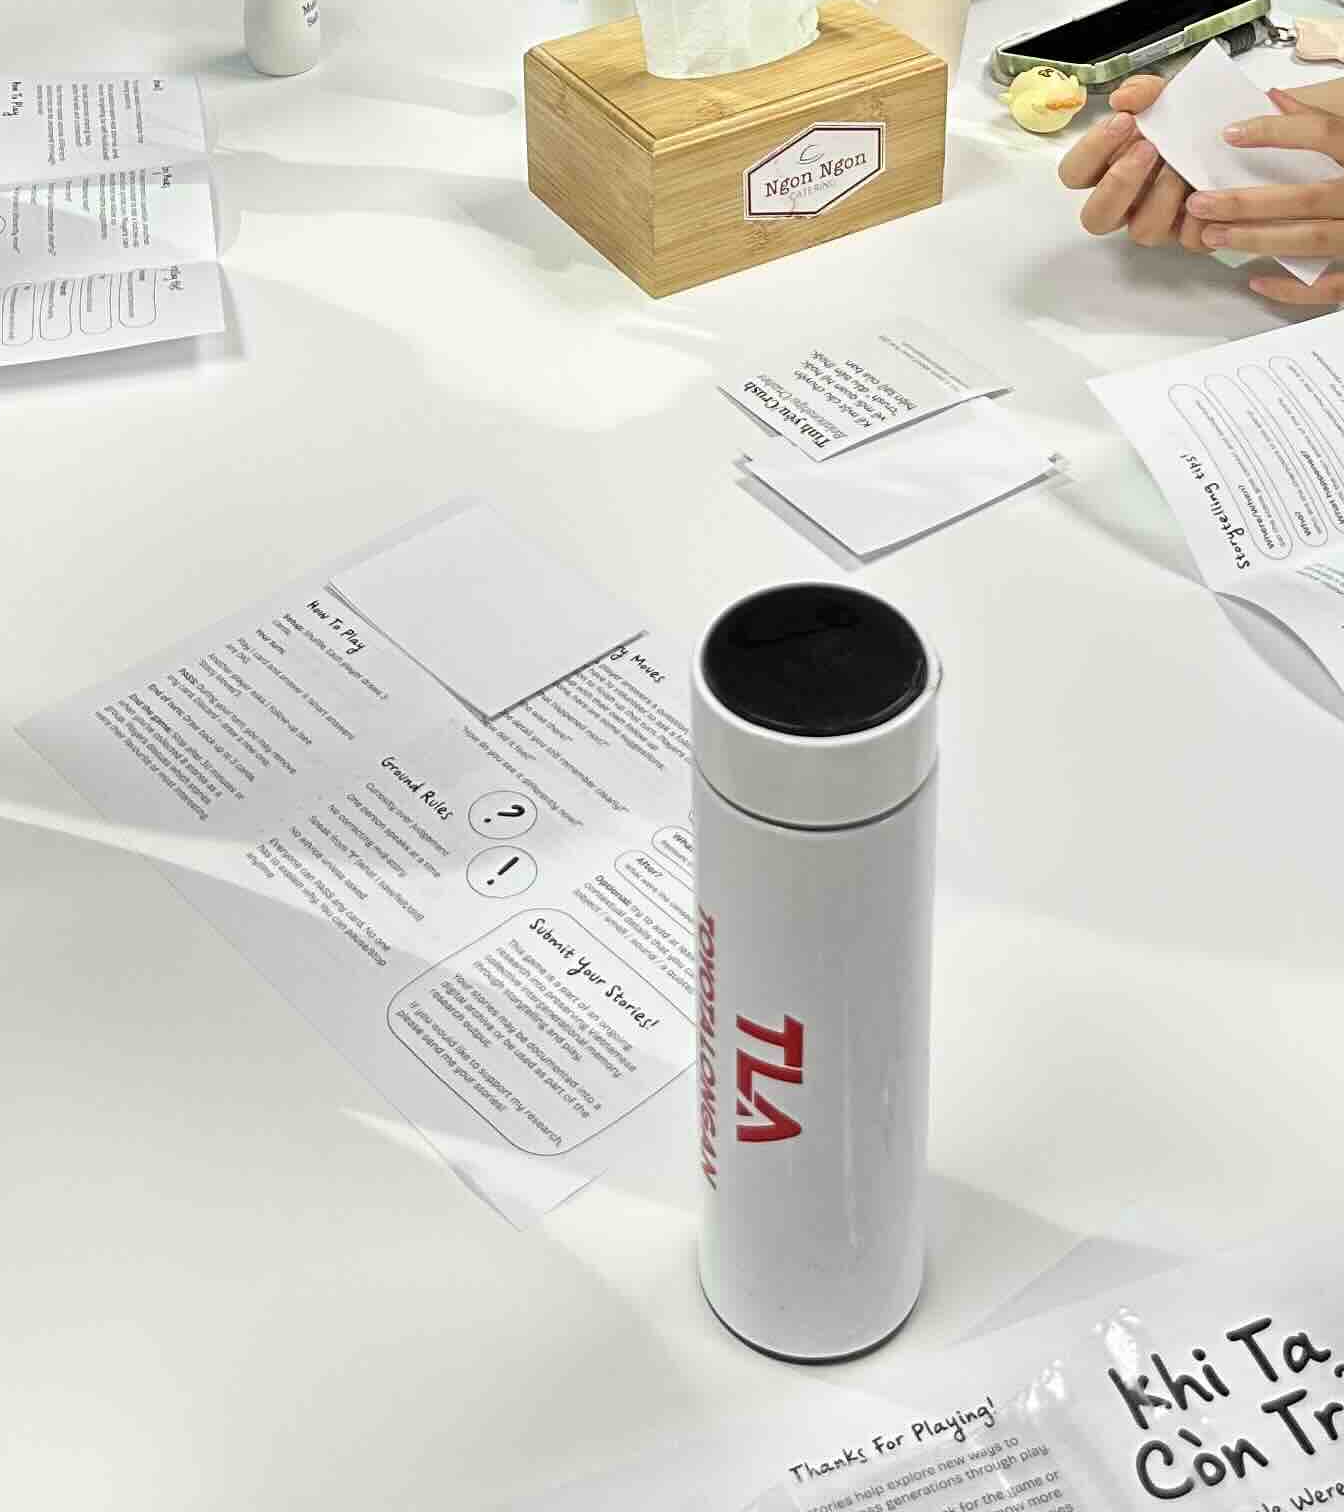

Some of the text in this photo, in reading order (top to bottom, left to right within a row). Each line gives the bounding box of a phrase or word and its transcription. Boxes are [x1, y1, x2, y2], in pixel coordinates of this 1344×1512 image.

[765, 152, 867, 198] Ngon Ngon
[743, 381, 780, 410] Crush
[1299, 445, 1333, 502] happened?
[1179, 454, 1251, 570] Storytelling tips!
[1294, 511, 1312, 537] Who?
[306, 599, 366, 656] How To Play
[629, 654, 666, 684] Moves
[380, 756, 454, 821] Ground Rules
[594, 874, 633, 907] Optional:
[635, 857, 664, 878] After?
[528, 917, 660, 1031] Submit Your Stories!
[428, 988, 493, 1049] research output.
[452, 973, 602, 1111] Your stories may be documented into a
[471, 959, 584, 1063] through storytelling and play.
[483, 954, 623, 1079] collective intergenerational memory
[495, 946, 638, 1073] research into preserving Vietnamese
[394, 1009, 508, 1113] please send me your stories!
[736, 1013, 804, 1142] TLA
[1225, 1316, 1332, 1383] Ta
[788, 1395, 997, 1484] Thanks For Playing!
[855, 1485, 885, 1502] help
[886, 1465, 937, 1493] explore
[937, 1457, 966, 1473] new
[968, 1443, 1004, 1464] ways
[1004, 1437, 1019, 1450] to
[1135, 1427, 1270, 1501] Còn
[885, 1473, 965, 1509] generations
[965, 1454, 1018, 1482] through
[959, 1493, 981, 1511] for
[982, 1487, 1006, 1505] the
[1045, 1470, 1061, 1484] or
[1026, 1487, 1064, 1508] more
